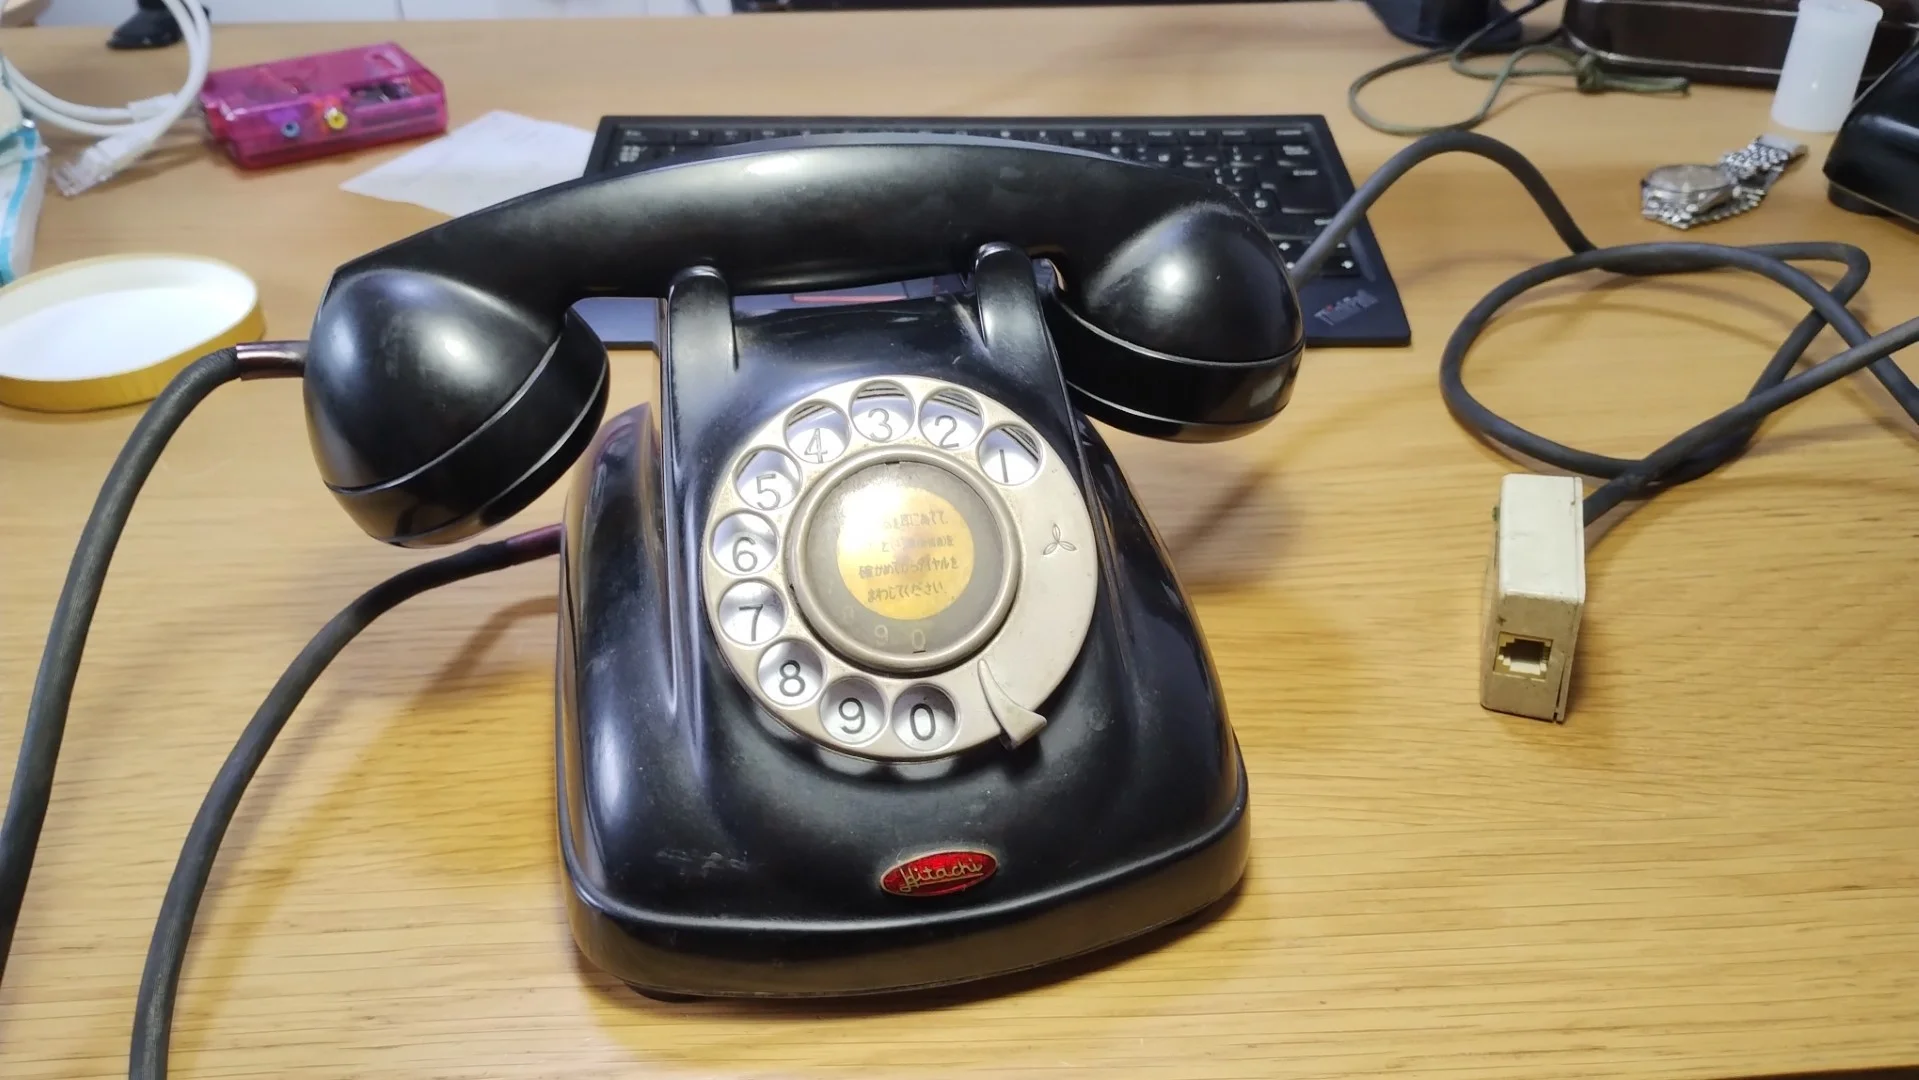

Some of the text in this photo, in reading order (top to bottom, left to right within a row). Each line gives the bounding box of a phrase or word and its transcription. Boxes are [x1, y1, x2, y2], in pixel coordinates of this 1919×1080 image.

[867, 407, 893, 443] 3
[934, 415, 960, 450] 2
[804, 427, 829, 464] 4
[999, 448, 1009, 483] 1
[755, 472, 782, 511] 5
[731, 536, 759, 573] 6
[738, 603, 764, 643] 7
[778, 658, 807, 698] 8
[837, 696, 867, 735] 9
[908, 701, 937, 741] 0
[899, 858, 983, 893] Hitachi
